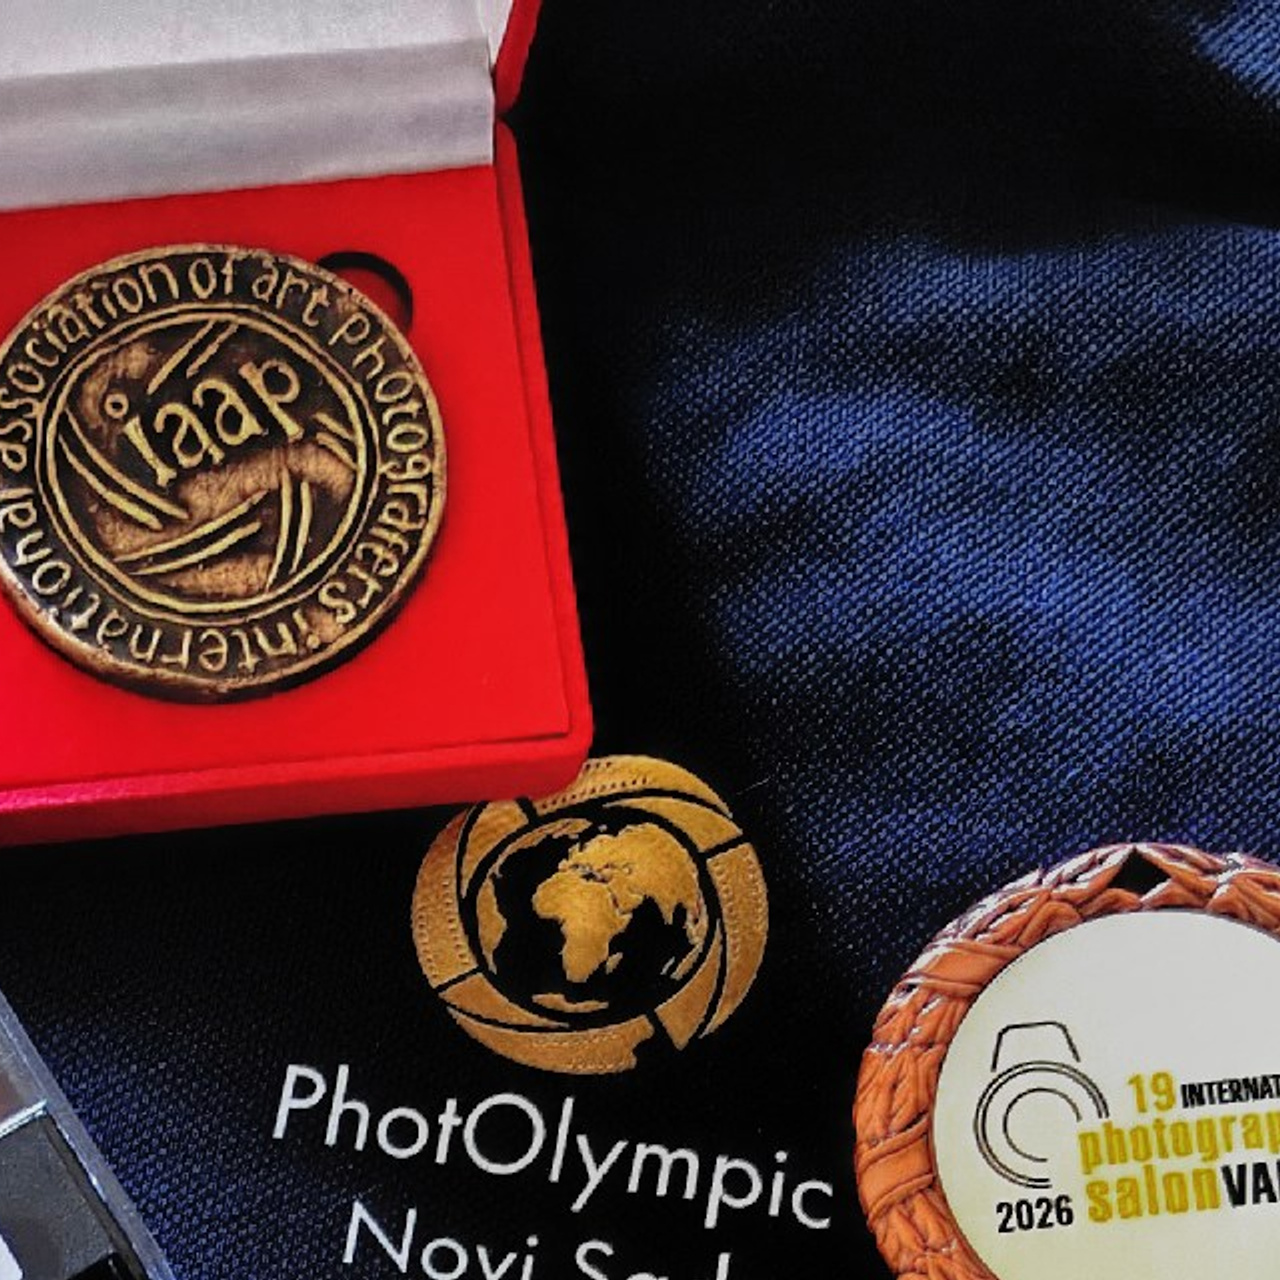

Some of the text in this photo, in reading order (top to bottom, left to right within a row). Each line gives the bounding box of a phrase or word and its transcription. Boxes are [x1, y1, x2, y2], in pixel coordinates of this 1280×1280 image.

[187, 253, 238, 300] of
[251, 262, 333, 328] art
[104, 358, 304, 487] iaap
[1127, 1071, 1176, 1113] 19
[272, 1063, 833, 1229] PhotOlympic
[995, 1195, 1075, 1234] 2026
